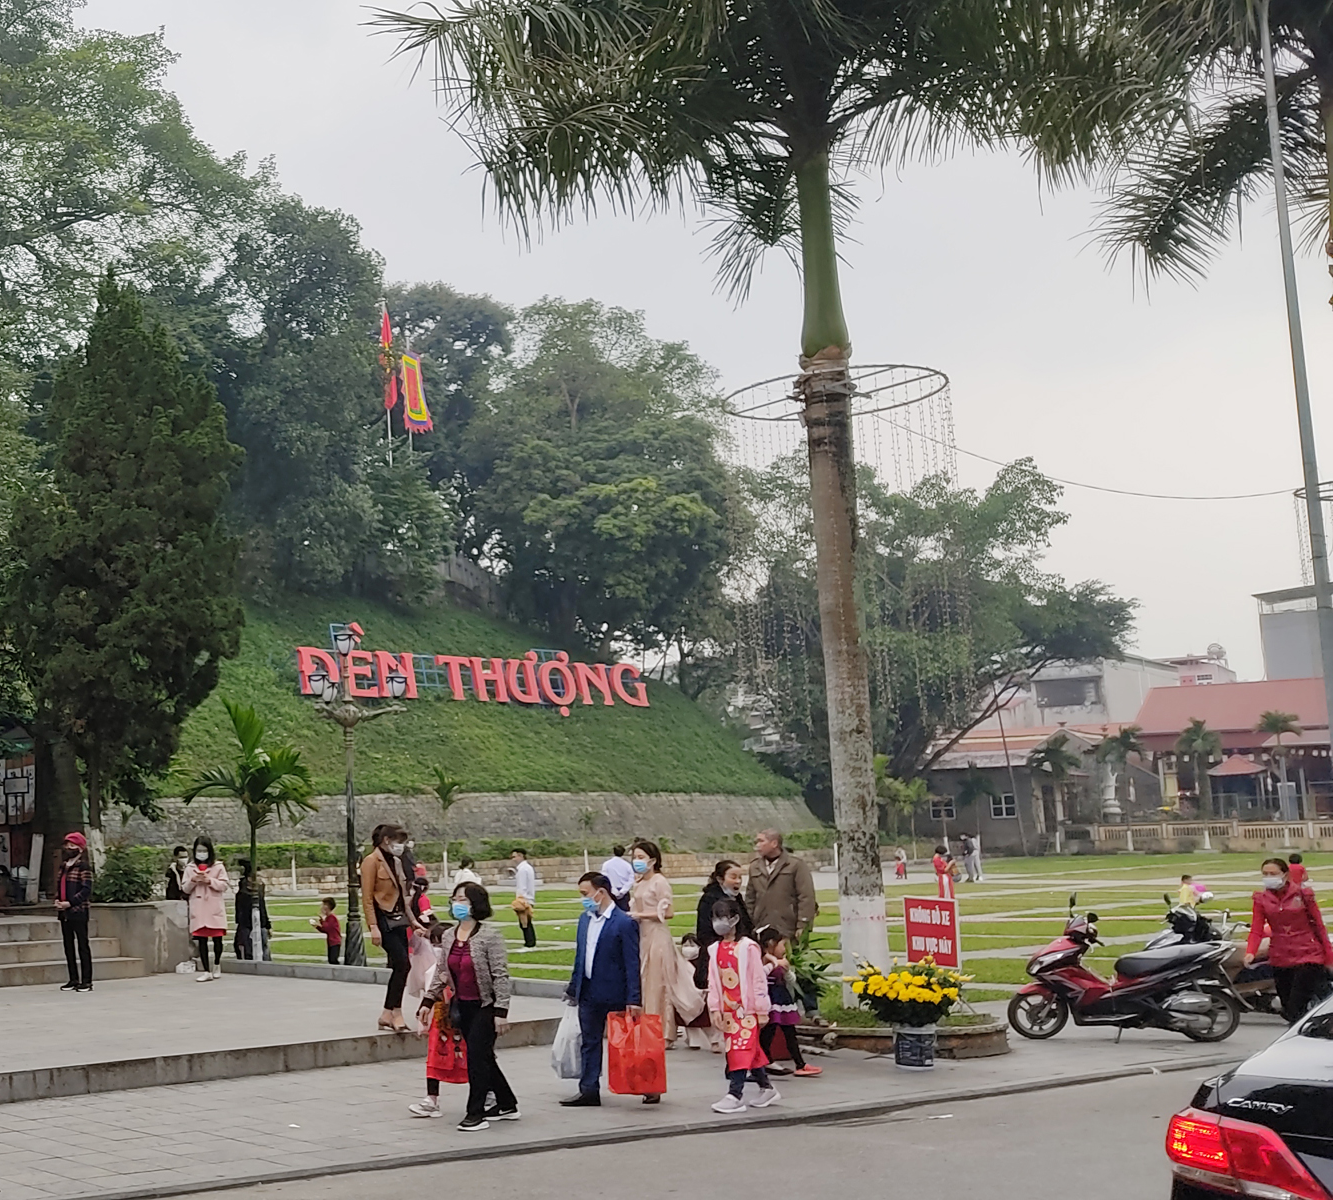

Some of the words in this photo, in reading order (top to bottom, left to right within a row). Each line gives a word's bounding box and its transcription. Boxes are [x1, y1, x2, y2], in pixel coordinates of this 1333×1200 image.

[434, 650, 651, 718] THƯỢNG
[941, 910, 951, 926] XE
[1227, 1098, 1294, 1115] CAMRY
